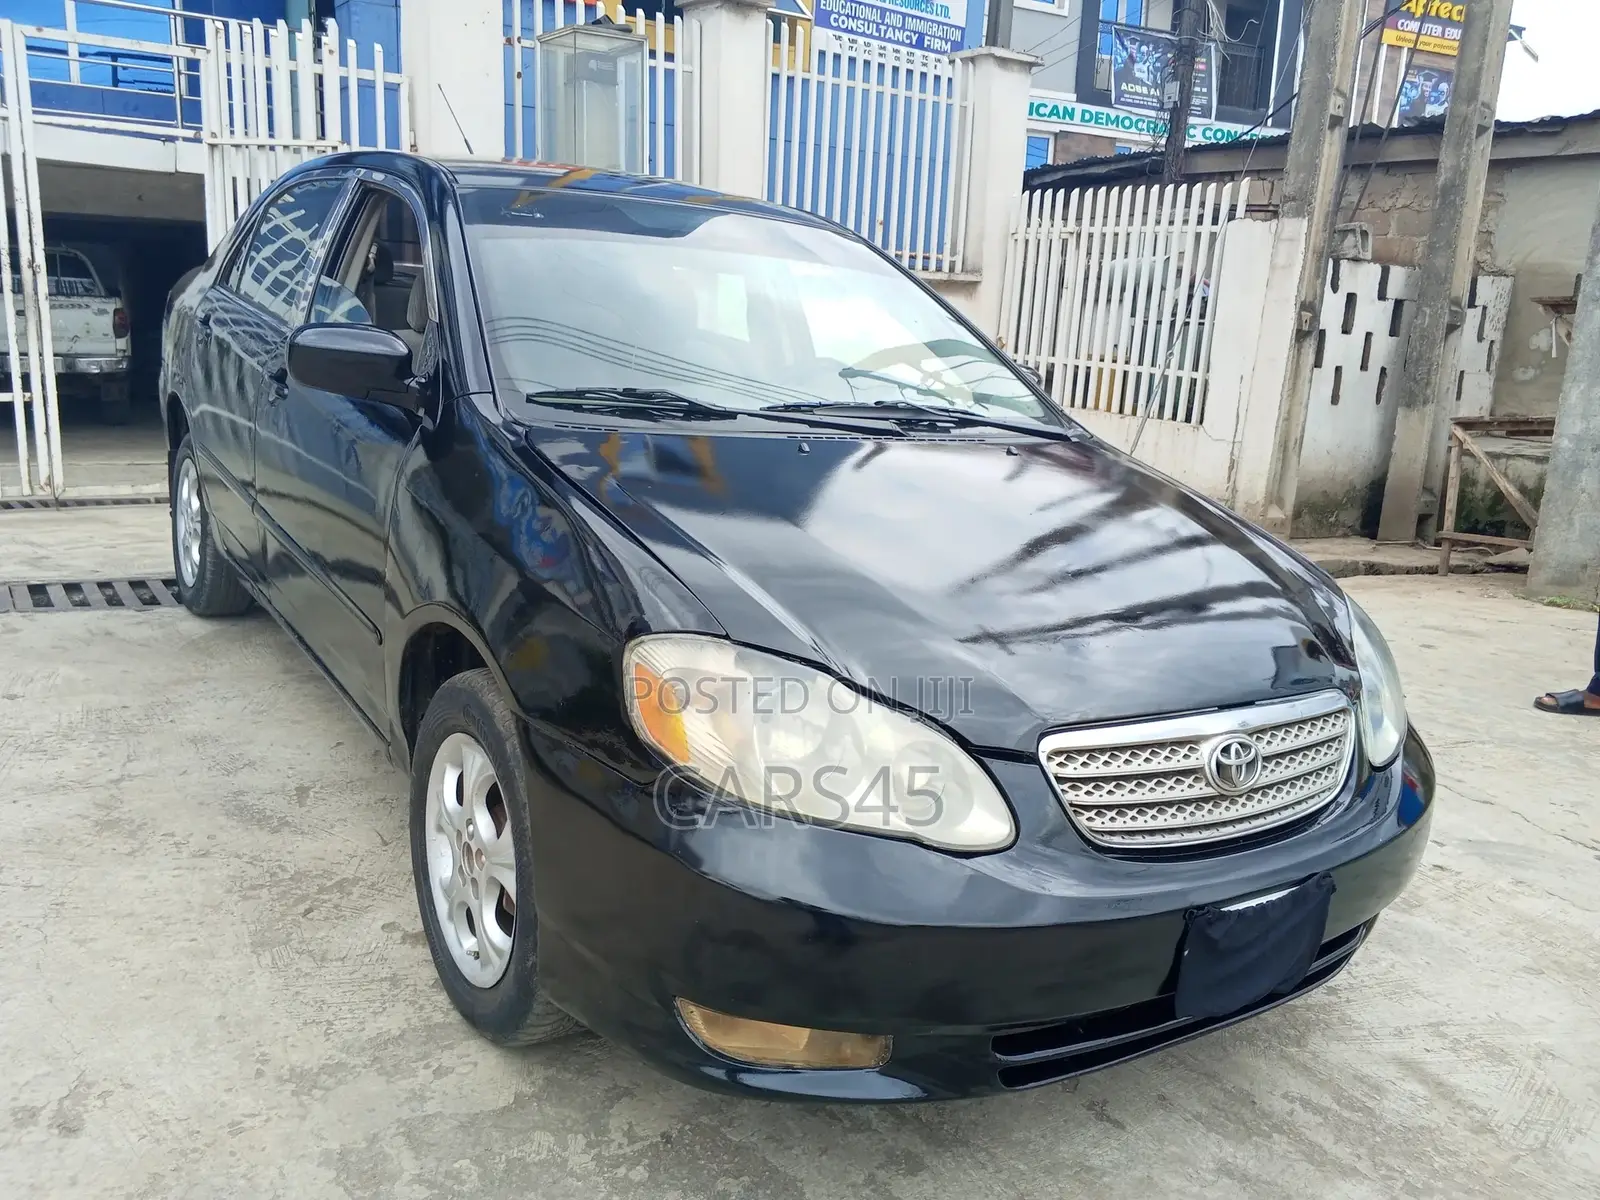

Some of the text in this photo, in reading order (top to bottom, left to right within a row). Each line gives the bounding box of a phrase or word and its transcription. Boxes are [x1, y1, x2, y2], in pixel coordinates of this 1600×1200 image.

[820, 0, 962, 42] EDUCATIONAL AND IMMIGRATION
[935, 3, 951, 19] LTD.
[1399, 0, 1466, 22] Aptec
[830, 13, 919, 45] CONSULTANCY
[924, 38, 952, 53] FIRM
[1432, 42, 1459, 52] potentia
[1028, 102, 1076, 121] ICAN
